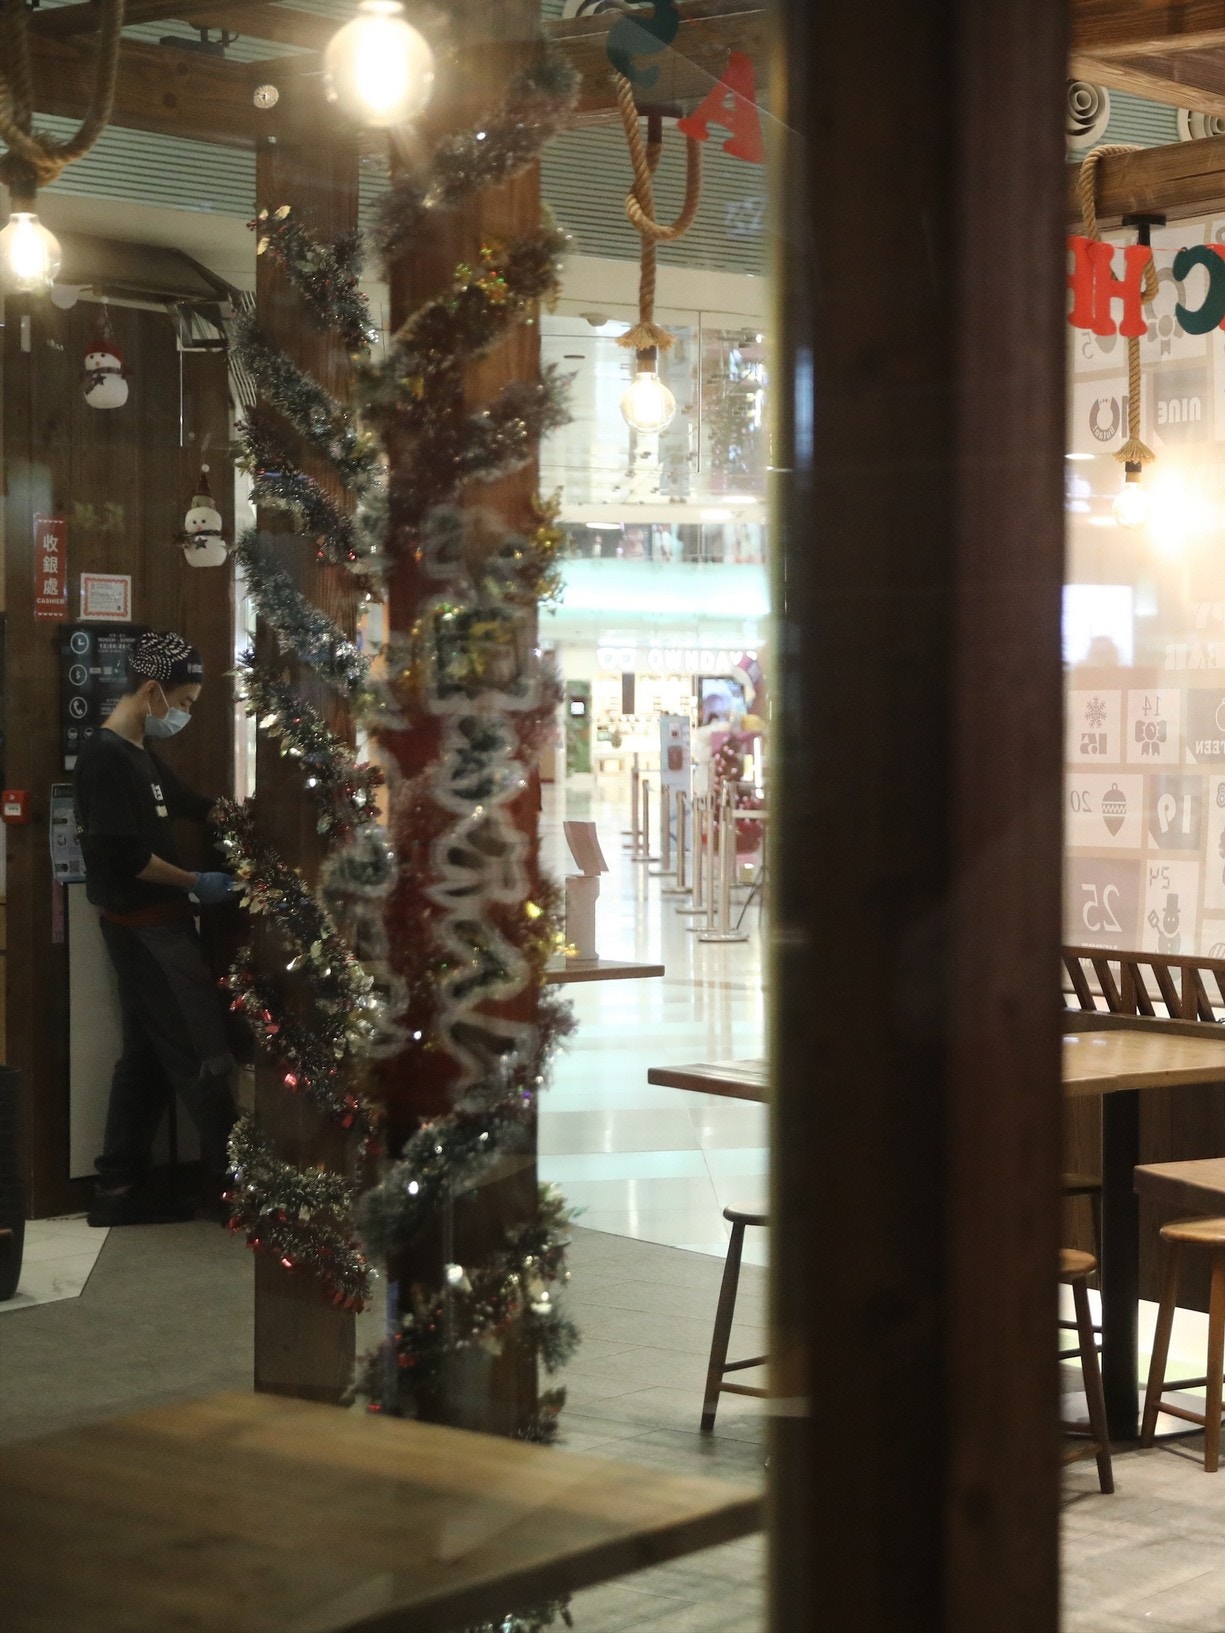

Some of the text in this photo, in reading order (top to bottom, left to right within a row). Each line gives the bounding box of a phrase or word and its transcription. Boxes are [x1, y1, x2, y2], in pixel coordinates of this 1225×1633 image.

[42, 533, 59, 596] 收銀處
[36, 597, 65, 605] CASHIER
